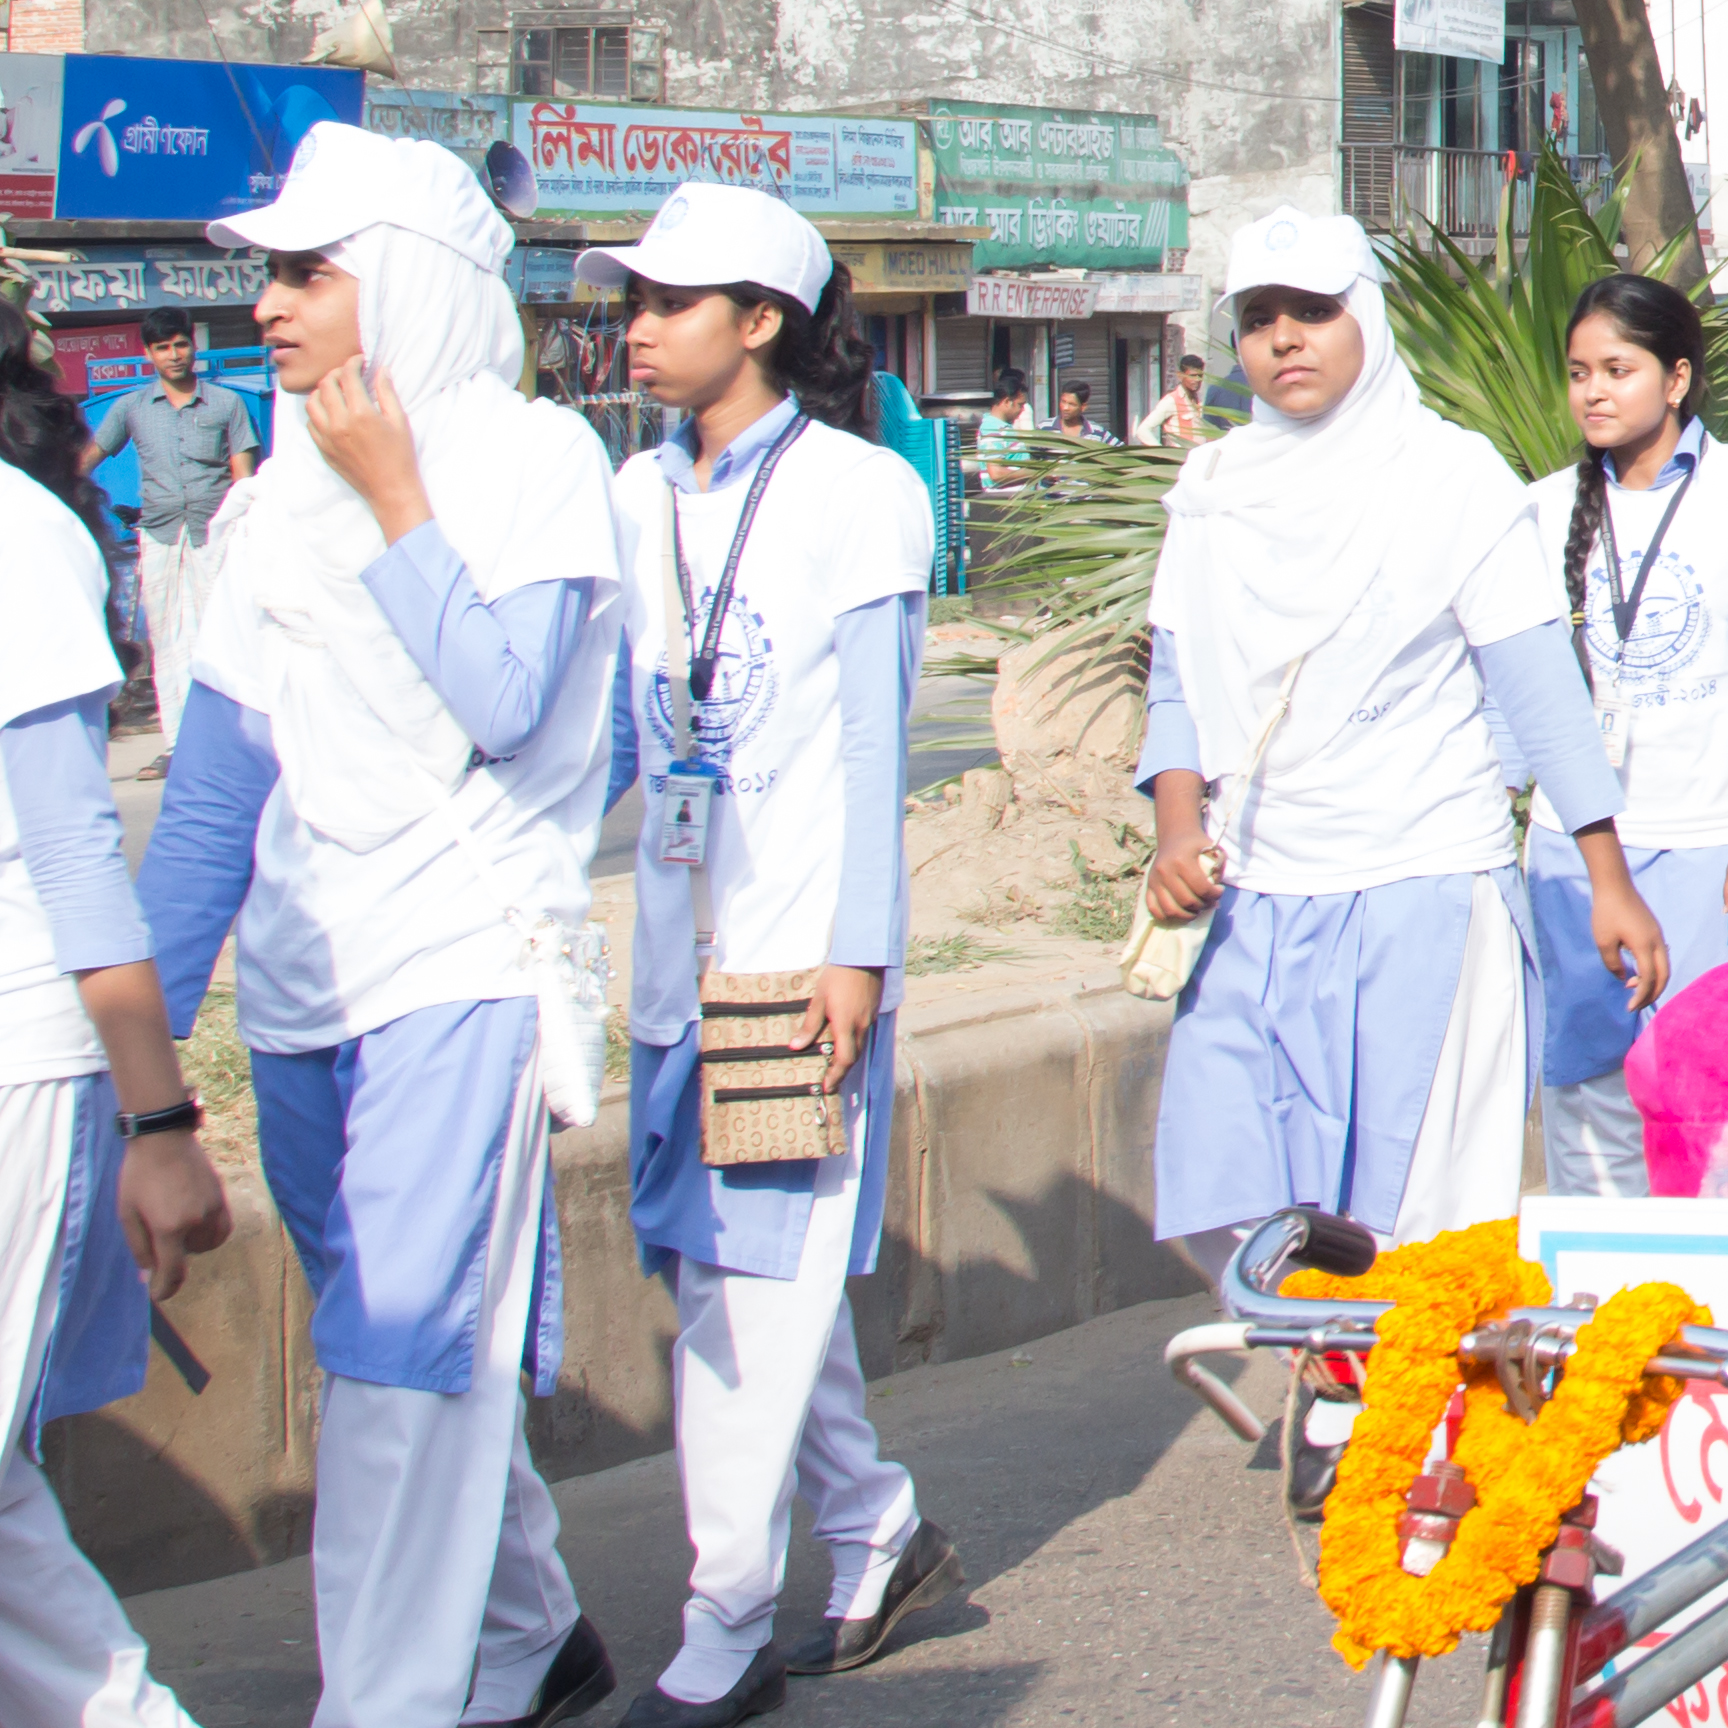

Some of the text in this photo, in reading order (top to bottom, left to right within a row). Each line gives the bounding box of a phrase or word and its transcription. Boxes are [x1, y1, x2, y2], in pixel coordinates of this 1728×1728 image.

[124, 116, 209, 155] গ্রামীণফোন
[528, 101, 618, 174] লিমা
[623, 113, 791, 181] ডেকোরেটর
[1000, 118, 1032, 153] আর
[1038, 114, 1115, 160] এন্টারপ্রাইজ
[985, 208, 1023, 246] আর
[1028, 197, 1079, 250] ড্রিংকিং
[1084, 201, 1143, 249] ওয়াটার
[1006, 284, 1090, 315] ENTERPRISE
